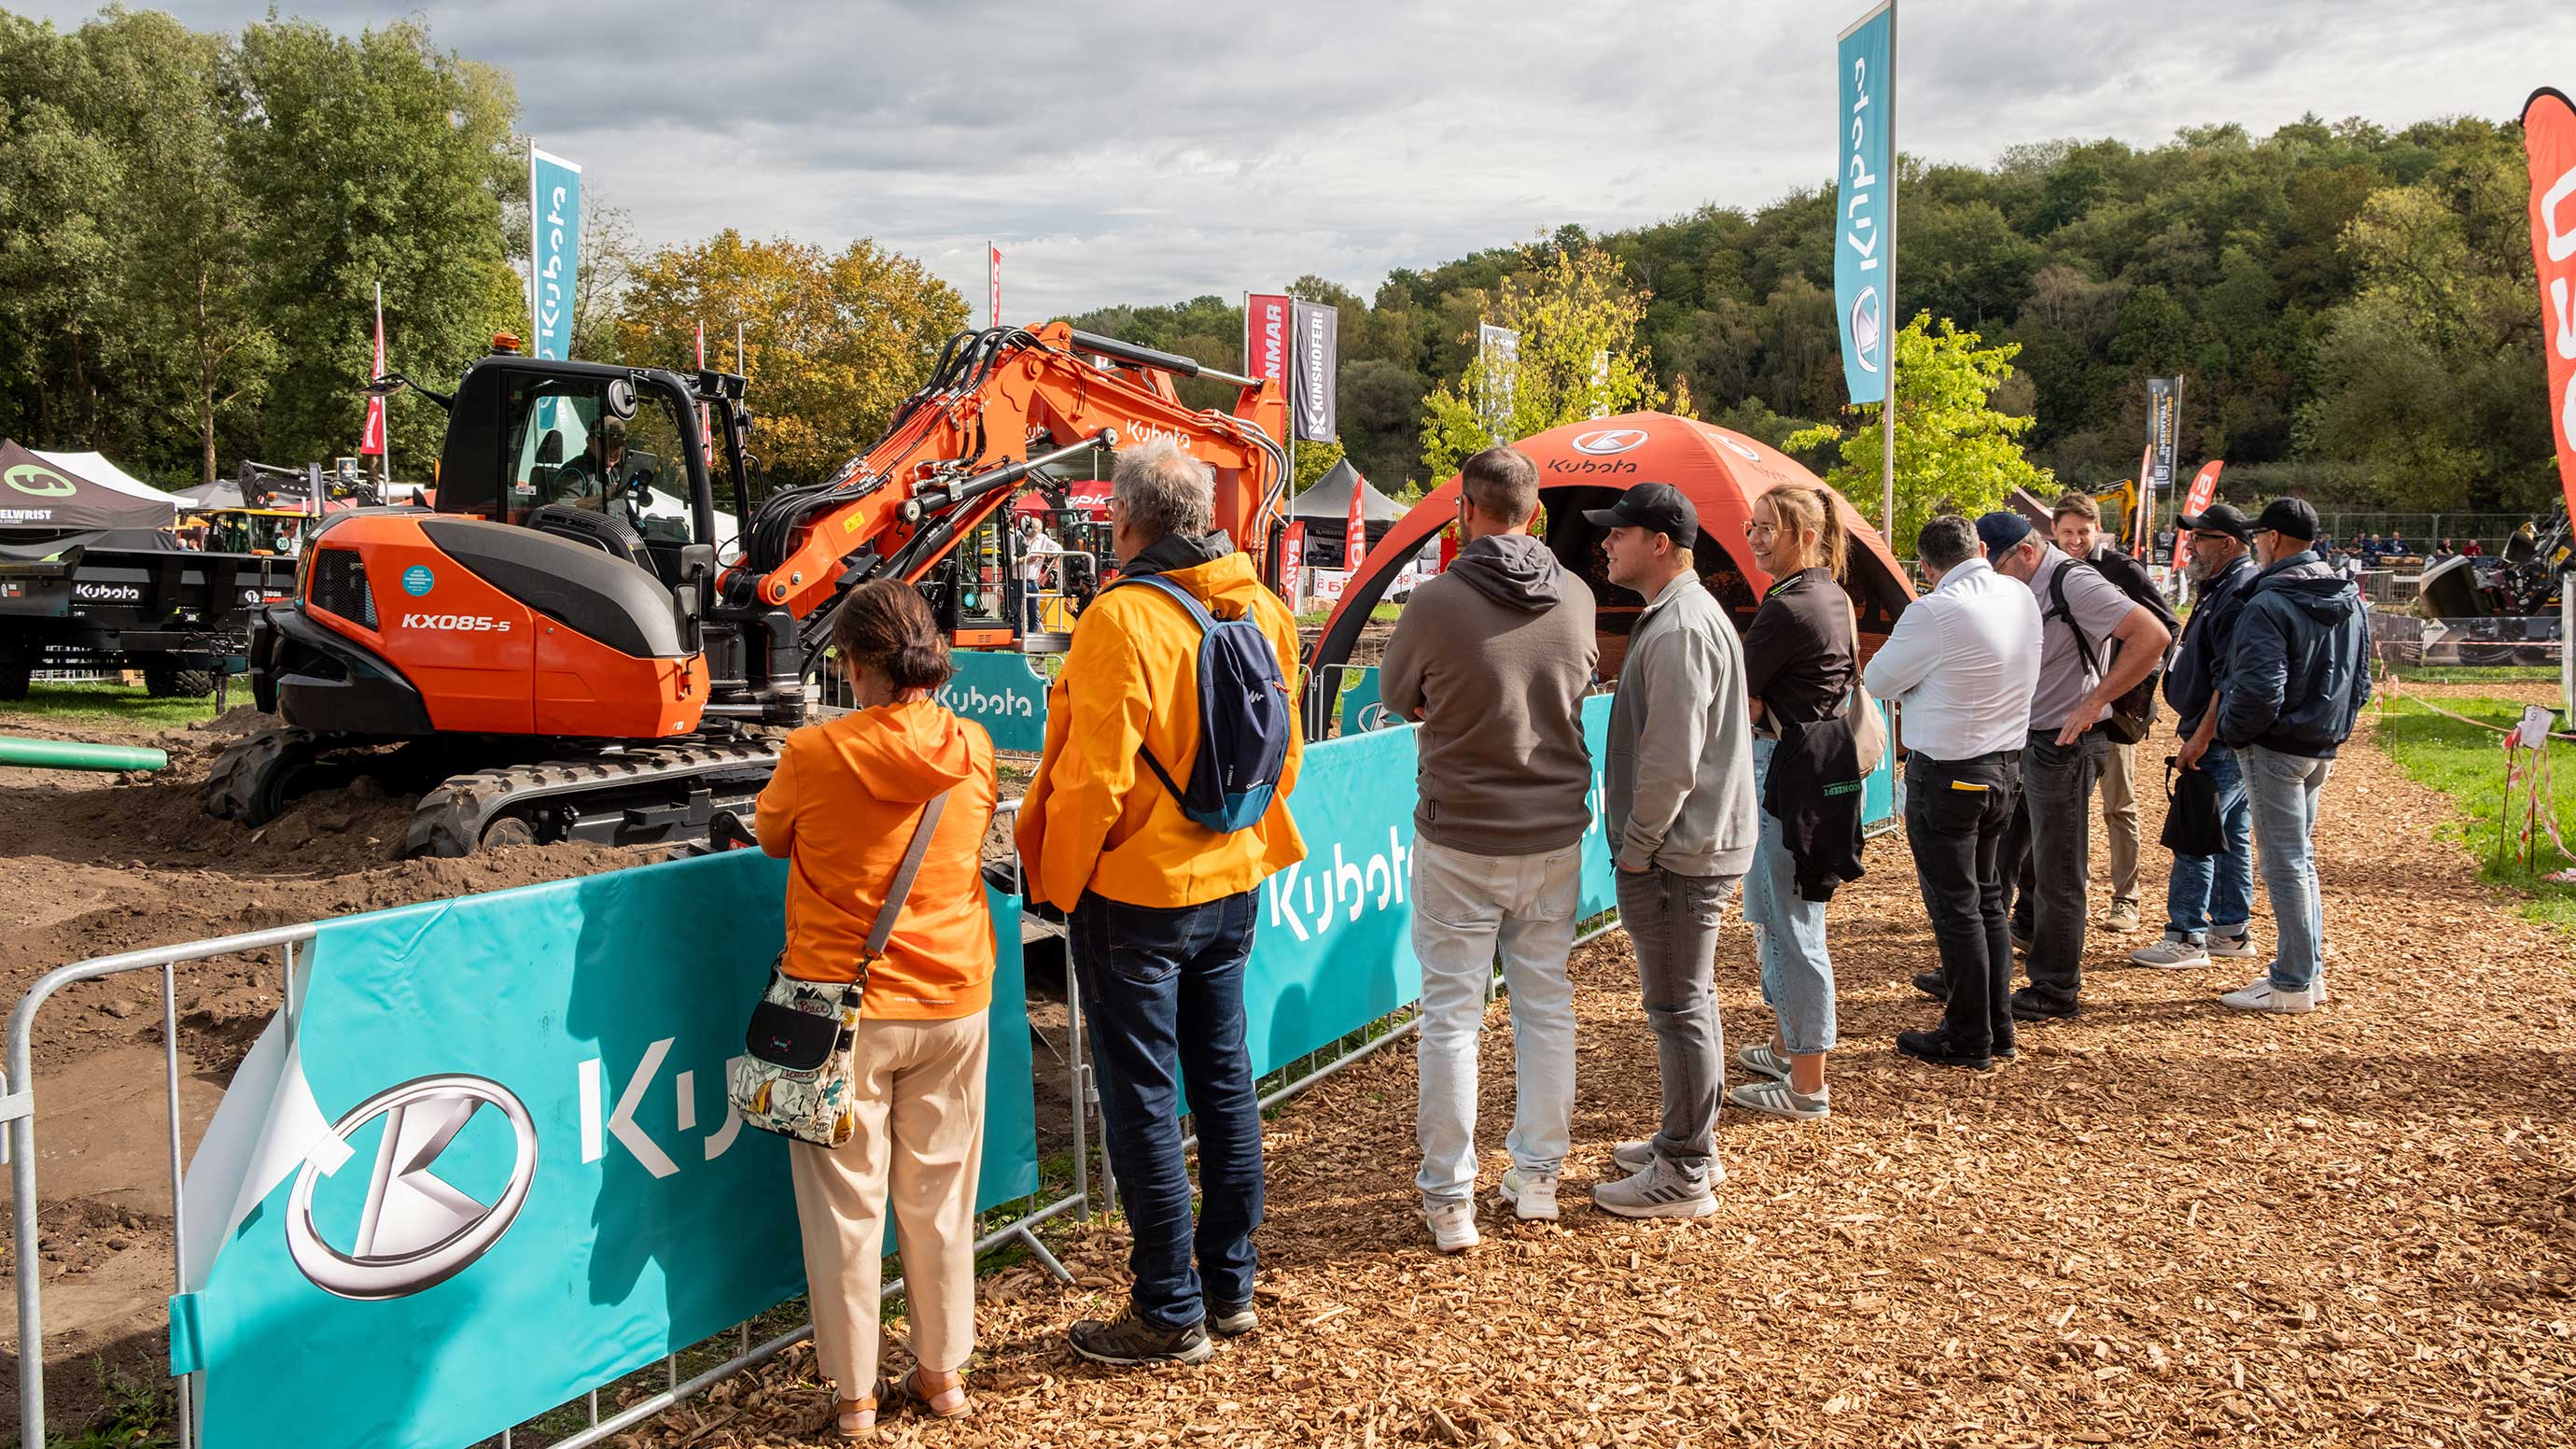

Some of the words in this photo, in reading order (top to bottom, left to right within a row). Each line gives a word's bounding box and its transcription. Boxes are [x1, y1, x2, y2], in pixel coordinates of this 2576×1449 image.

[542, 186, 566, 337] Kubota
[1265, 304, 1281, 383] NMAR
[1547, 458, 1637, 473] Kubota
[280, 484, 311, 493] VOLV
[279, 539, 287, 549] 20
[1286, 540, 1299, 592] SANY
[76, 584, 139, 600] Kubota
[936, 683, 1032, 718] Kubota
